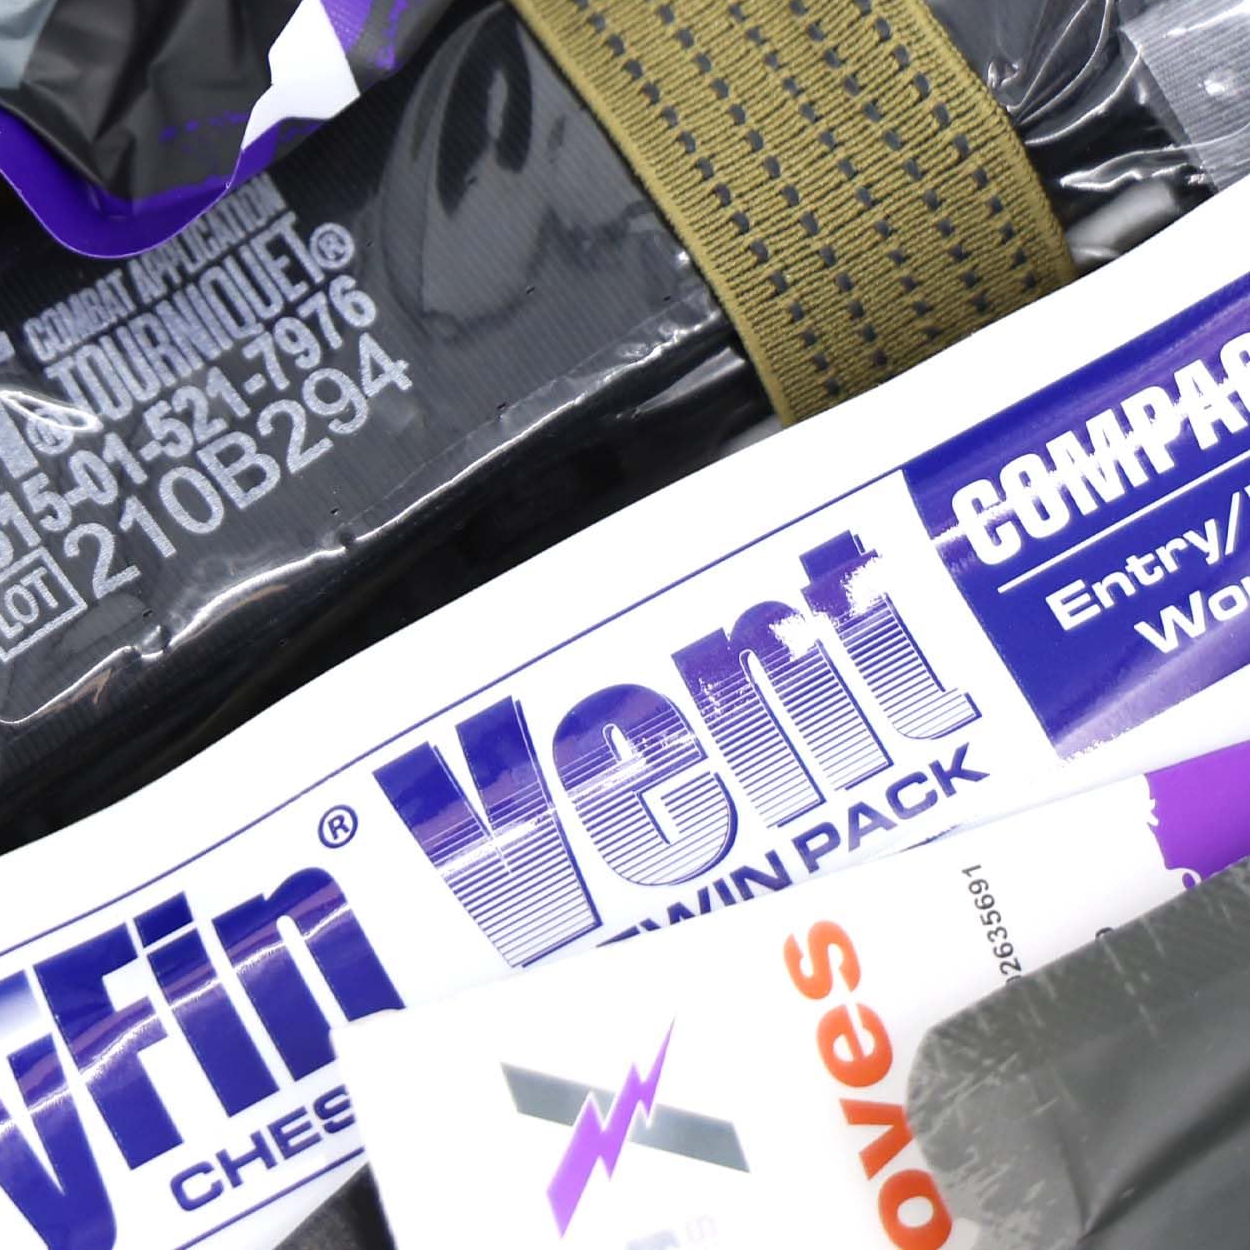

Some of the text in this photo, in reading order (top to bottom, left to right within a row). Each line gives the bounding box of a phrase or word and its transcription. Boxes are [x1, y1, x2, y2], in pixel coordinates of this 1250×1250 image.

[24, 172, 287, 362] COMBAT APPLICATION
[64, 333, 412, 600] 210B294
[1045, 484, 1250, 631] Entry/
[1134, 576, 1250, 654] Wo
[596, 742, 990, 948] WIN PACK
[961, 864, 1022, 983] 2635691
